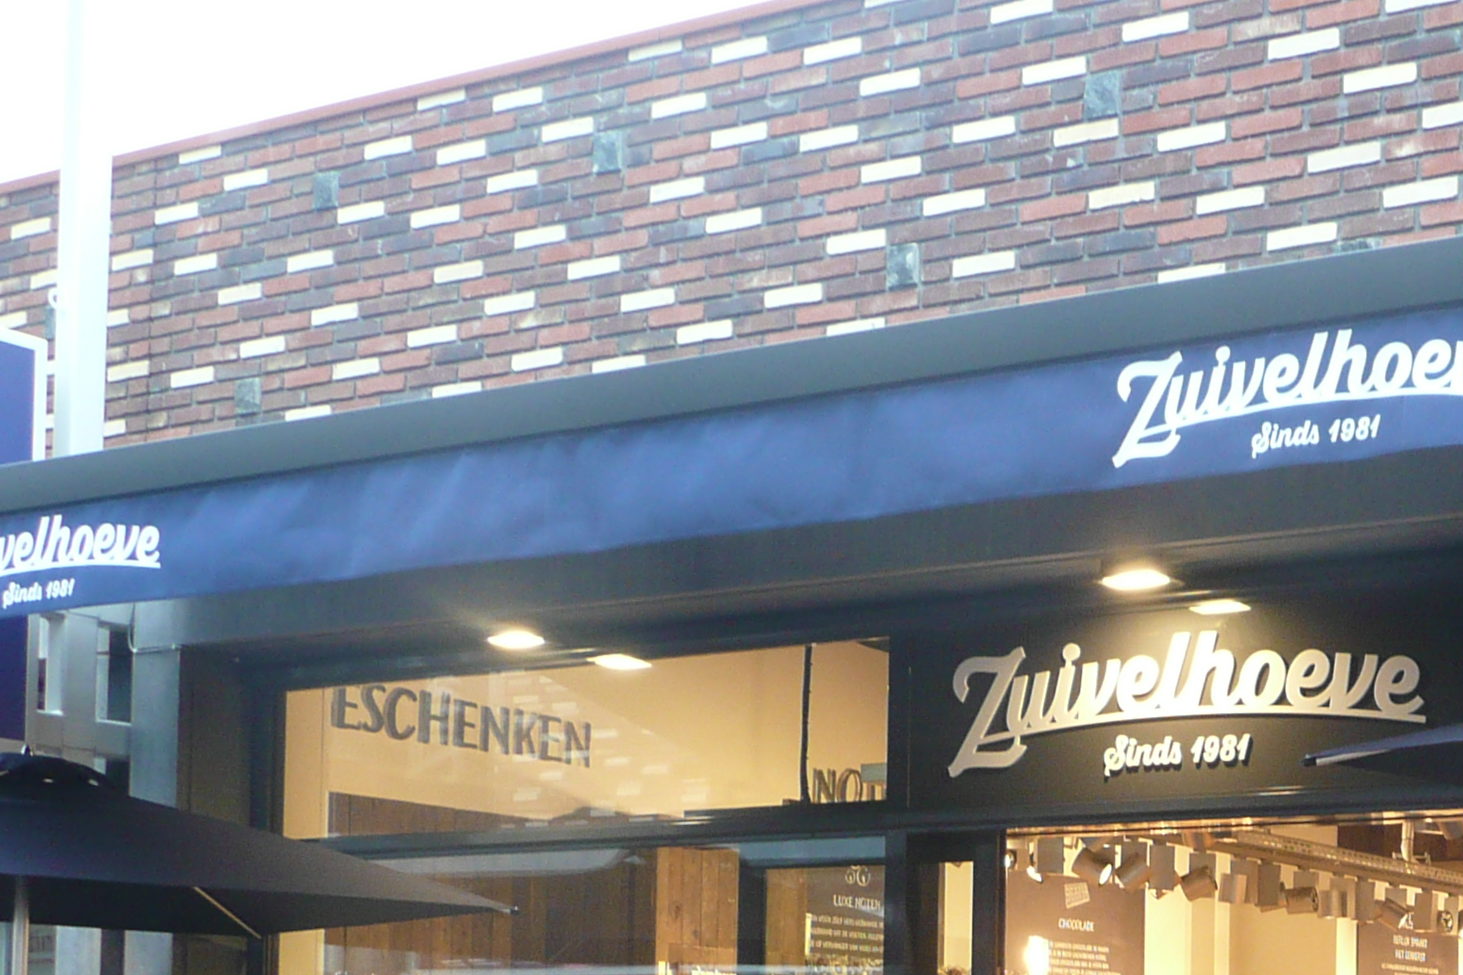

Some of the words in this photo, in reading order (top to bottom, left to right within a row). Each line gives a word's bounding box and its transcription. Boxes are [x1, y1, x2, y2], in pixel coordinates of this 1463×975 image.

[1251, 421, 1319, 459] Sinds
[1329, 414, 1381, 444] 1981
[3, 582, 42, 610] Sinds
[46, 578, 75, 599] 1981
[947, 631, 1427, 778] Zuivelhoeve
[1103, 734, 1182, 780] Sinds
[1190, 732, 1252, 766] 1981
[833, 894, 852, 909] LUXE
